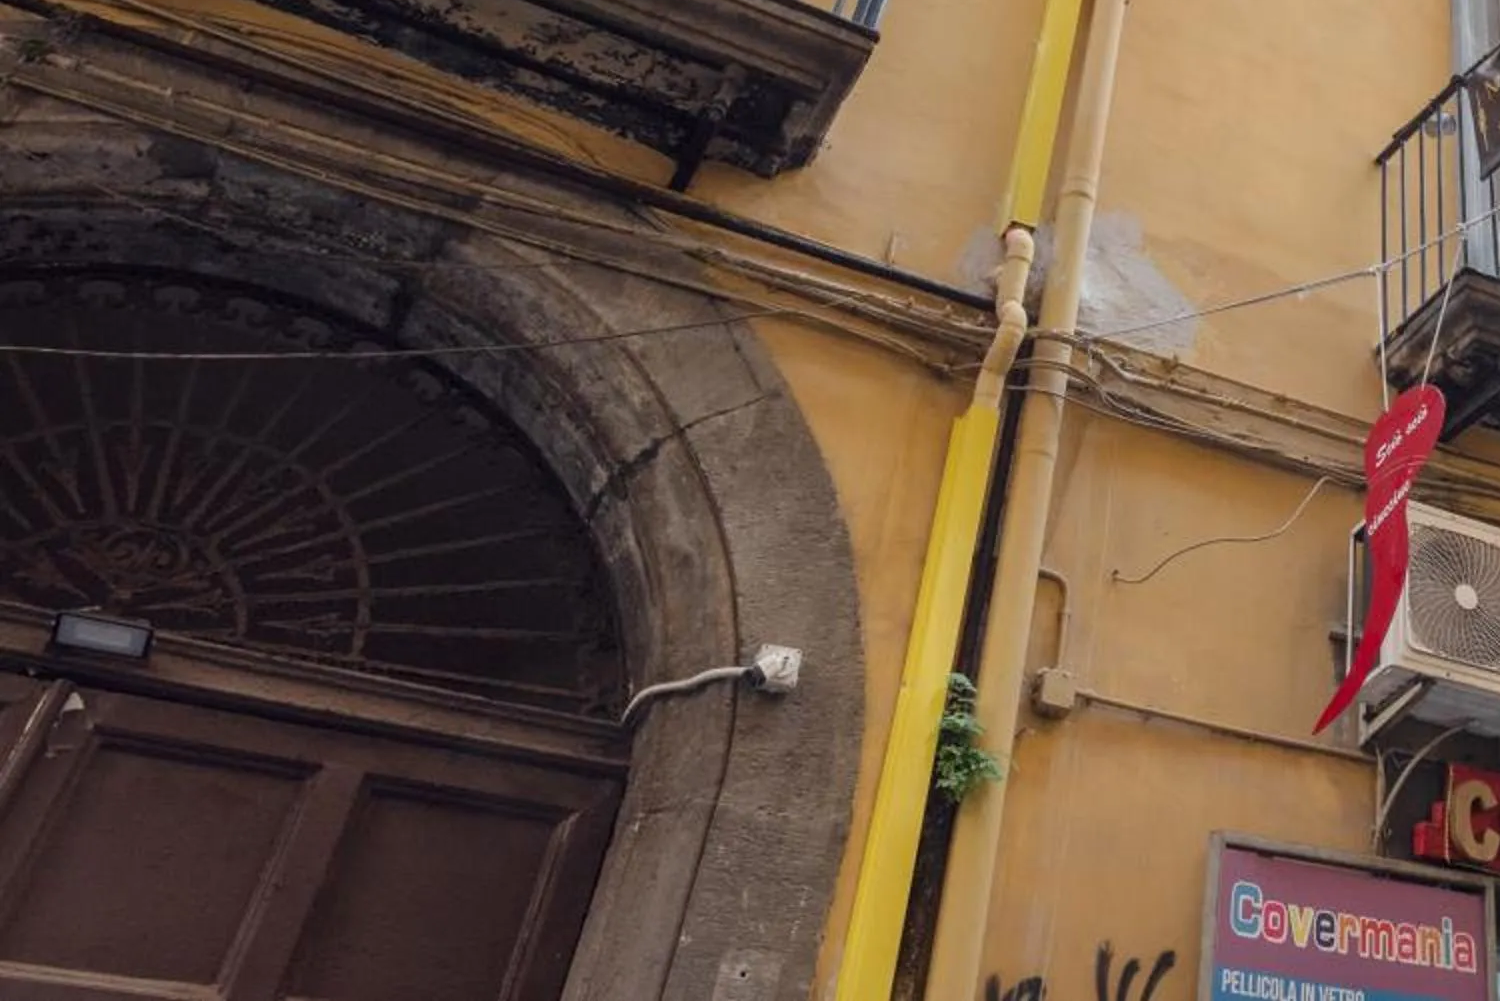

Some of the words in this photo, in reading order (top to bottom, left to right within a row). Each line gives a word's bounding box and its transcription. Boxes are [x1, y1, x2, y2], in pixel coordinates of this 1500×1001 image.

[1230, 880, 1477, 974] Covermania
[1221, 967, 1298, 1001] PELLICOLA
[1301, 982, 1316, 1001] IN
